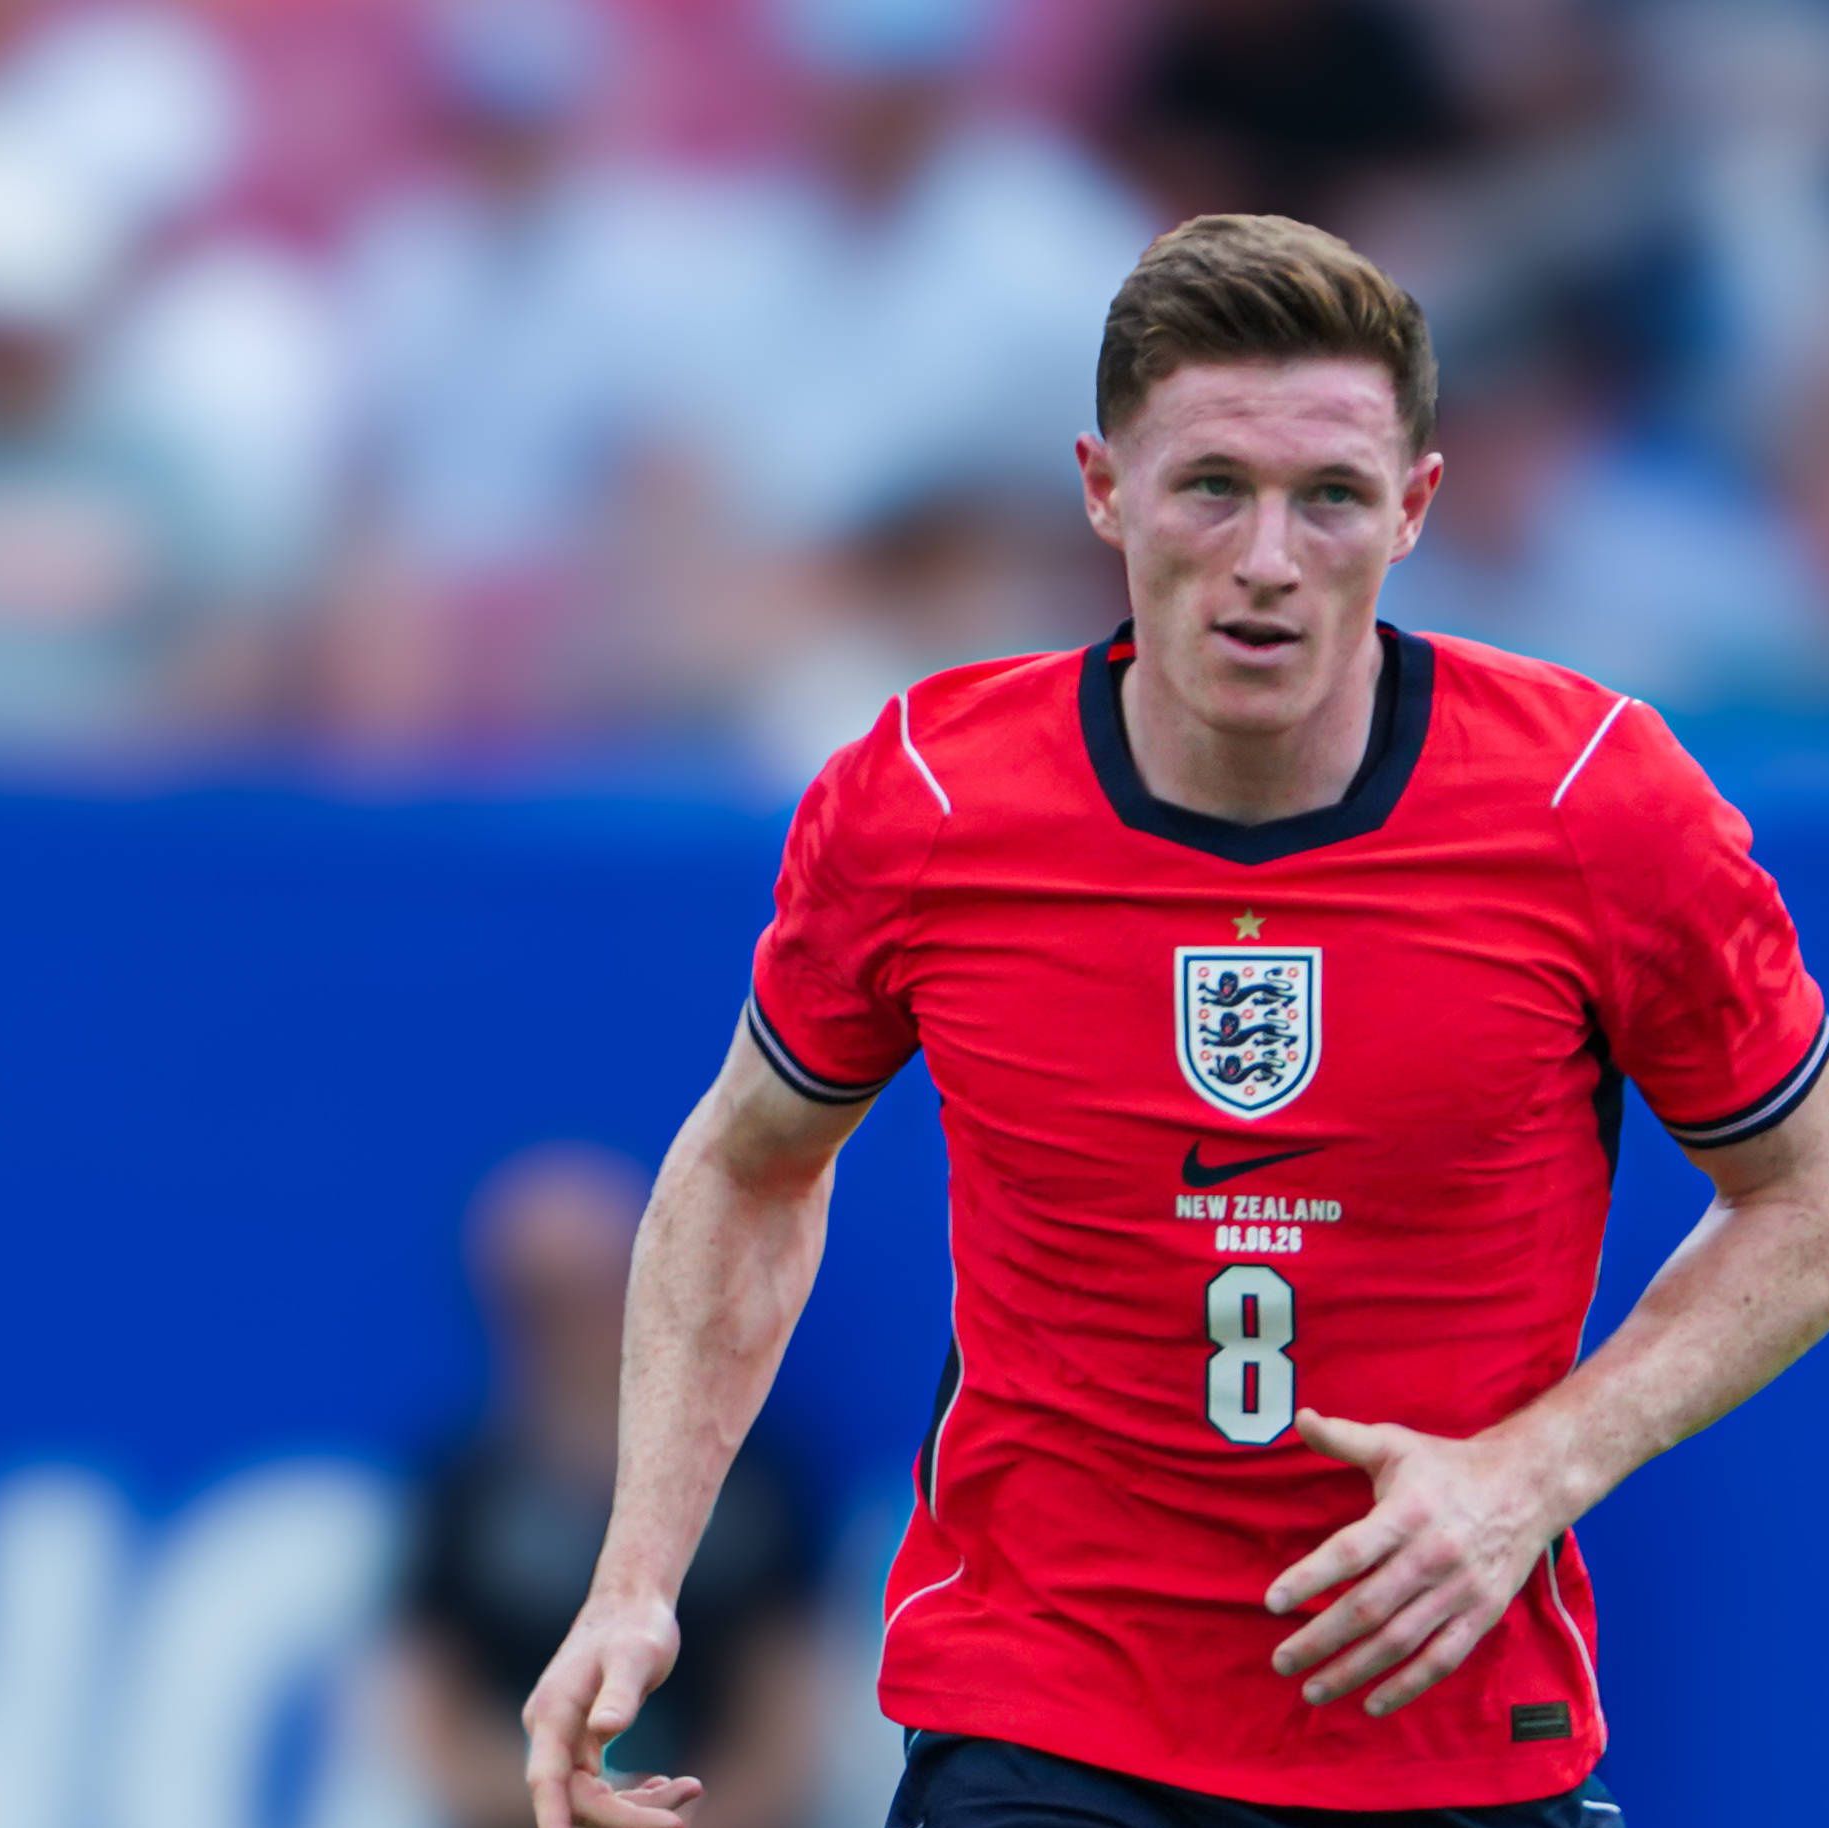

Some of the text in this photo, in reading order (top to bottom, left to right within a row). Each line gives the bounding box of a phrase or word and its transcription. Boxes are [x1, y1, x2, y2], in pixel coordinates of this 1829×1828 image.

[1175, 1194, 1342, 1222] NEW ZEALAND
[1214, 1224, 1303, 1253] 06.06.26
[1206, 1264, 1296, 1445] 8
